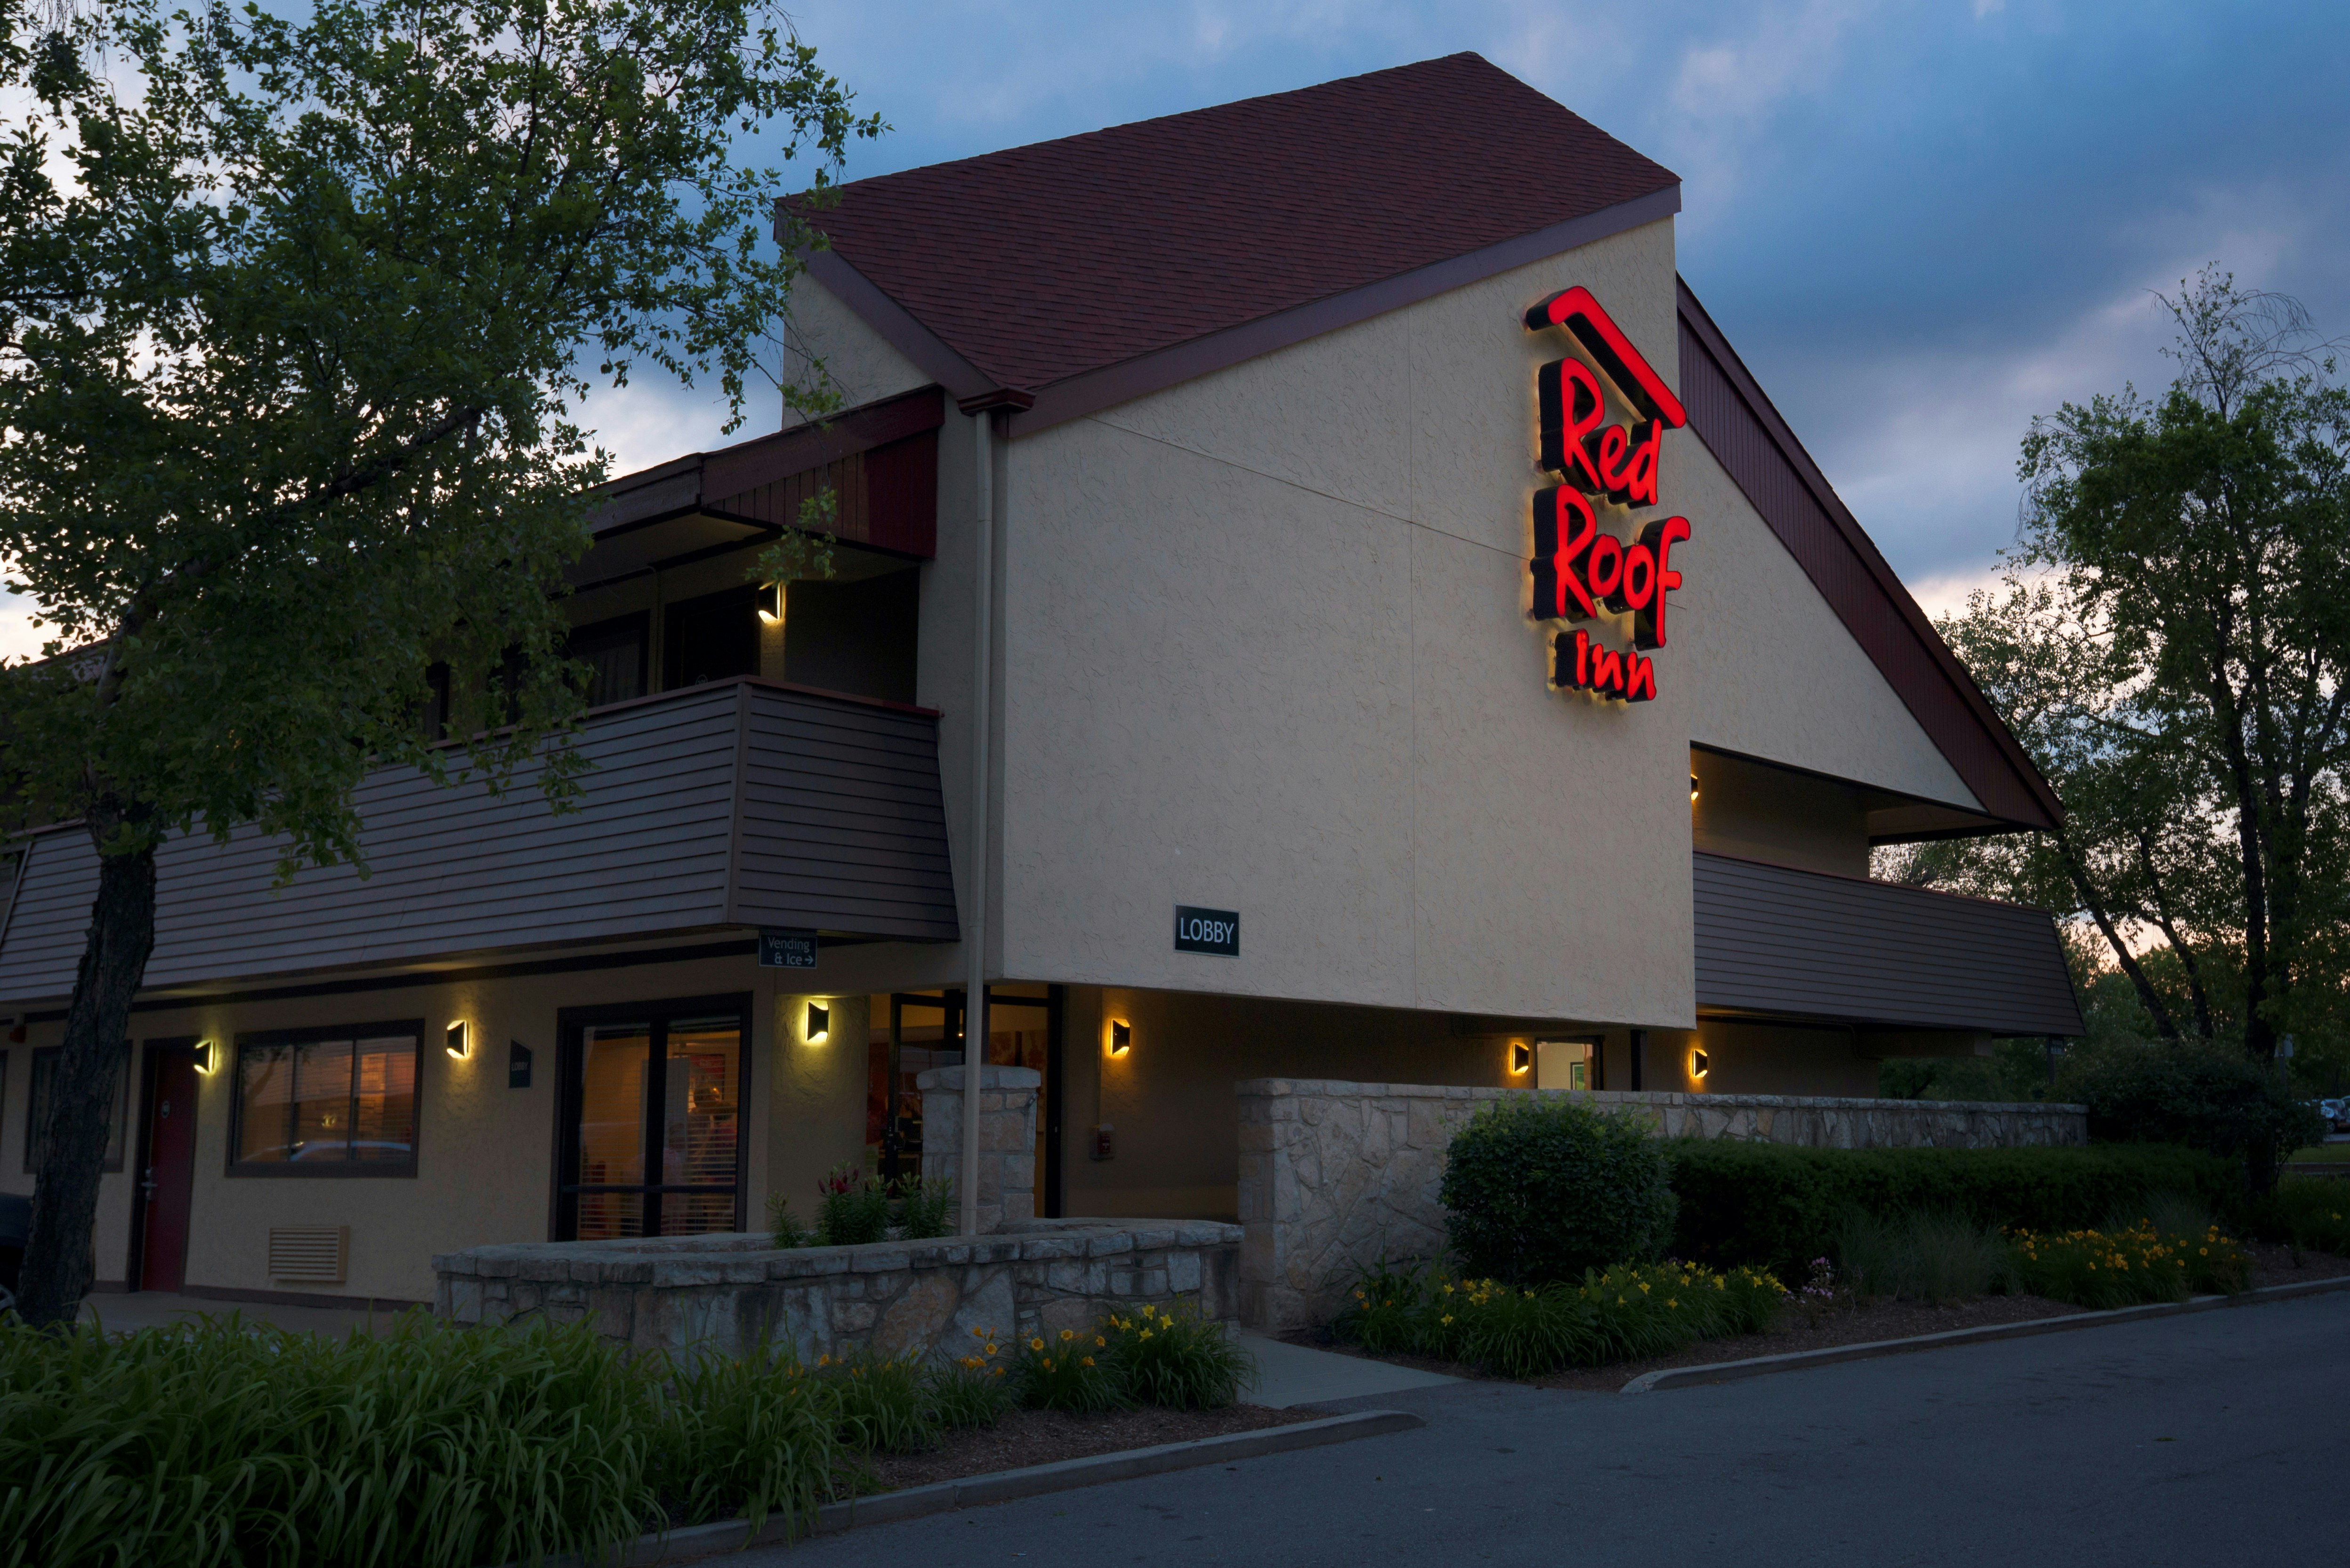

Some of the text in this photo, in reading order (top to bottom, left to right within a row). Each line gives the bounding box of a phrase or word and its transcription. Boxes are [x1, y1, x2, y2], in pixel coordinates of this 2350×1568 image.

[1560, 357, 1662, 506] Red
[1553, 483, 1691, 648] Roof
[1575, 628, 1657, 700] Inn
[1180, 917, 1235, 944] LOBBY
[767, 936, 810, 953] Vending
[774, 952, 803, 965] & Ice
[511, 1061, 528, 1071] LOBBY
